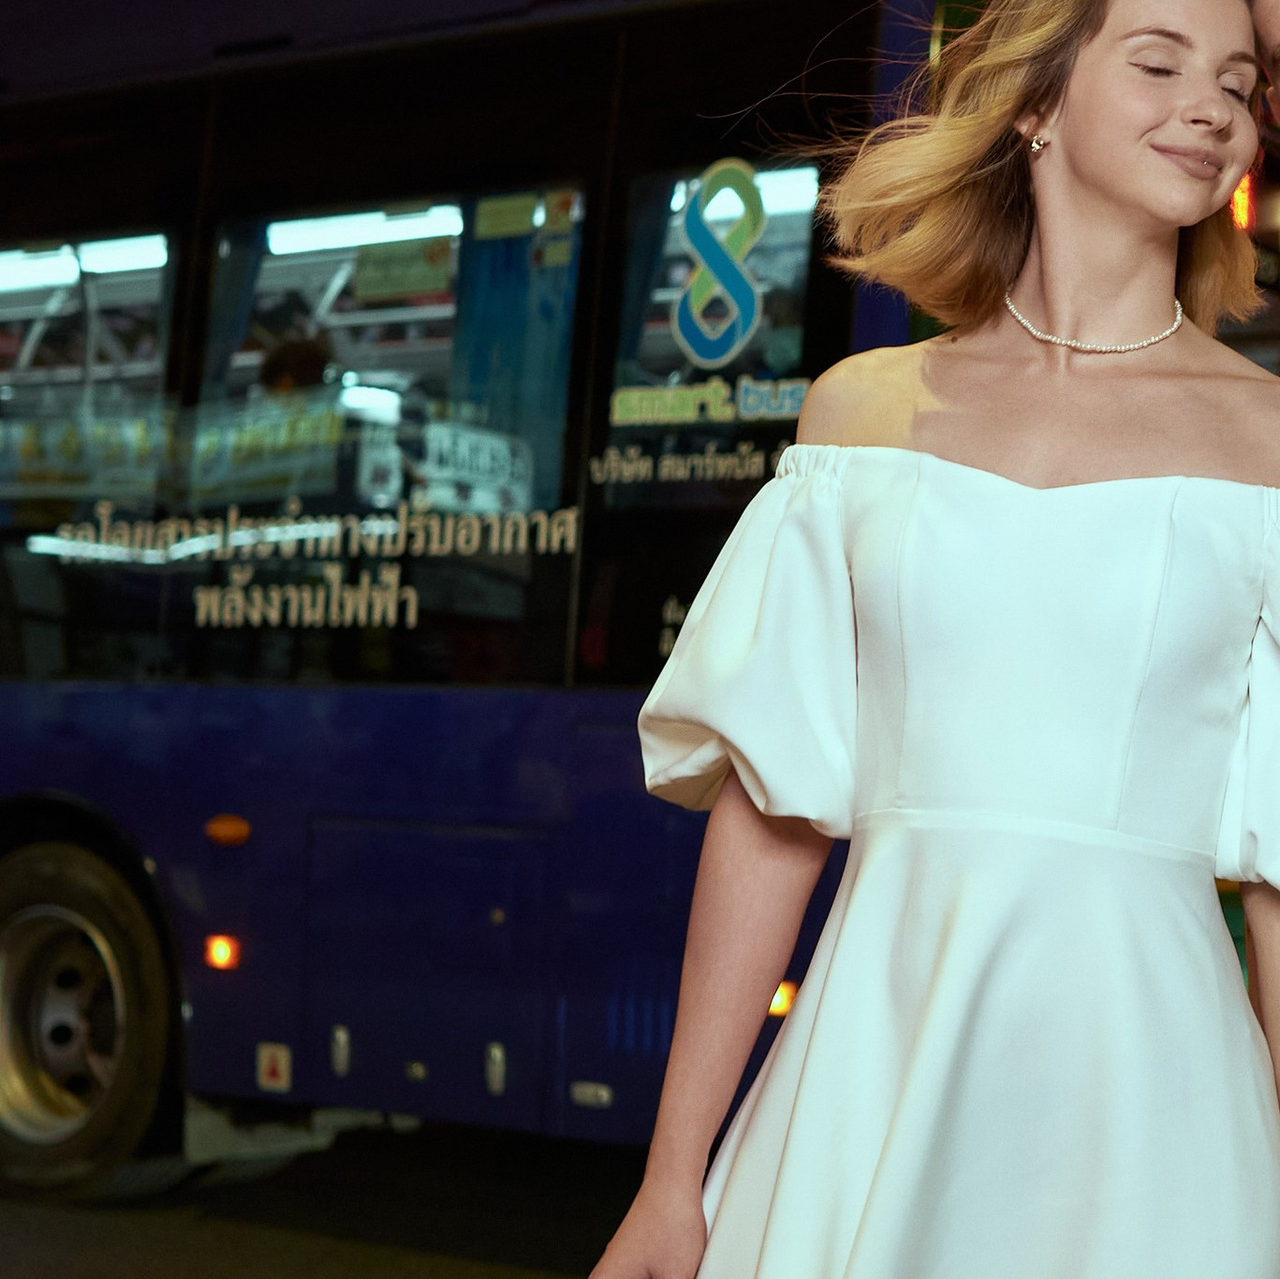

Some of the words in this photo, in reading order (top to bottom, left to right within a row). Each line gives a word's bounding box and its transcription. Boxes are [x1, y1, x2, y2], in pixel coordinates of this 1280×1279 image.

[193, 561, 420, 630] พลังงานไฟฟ้า
